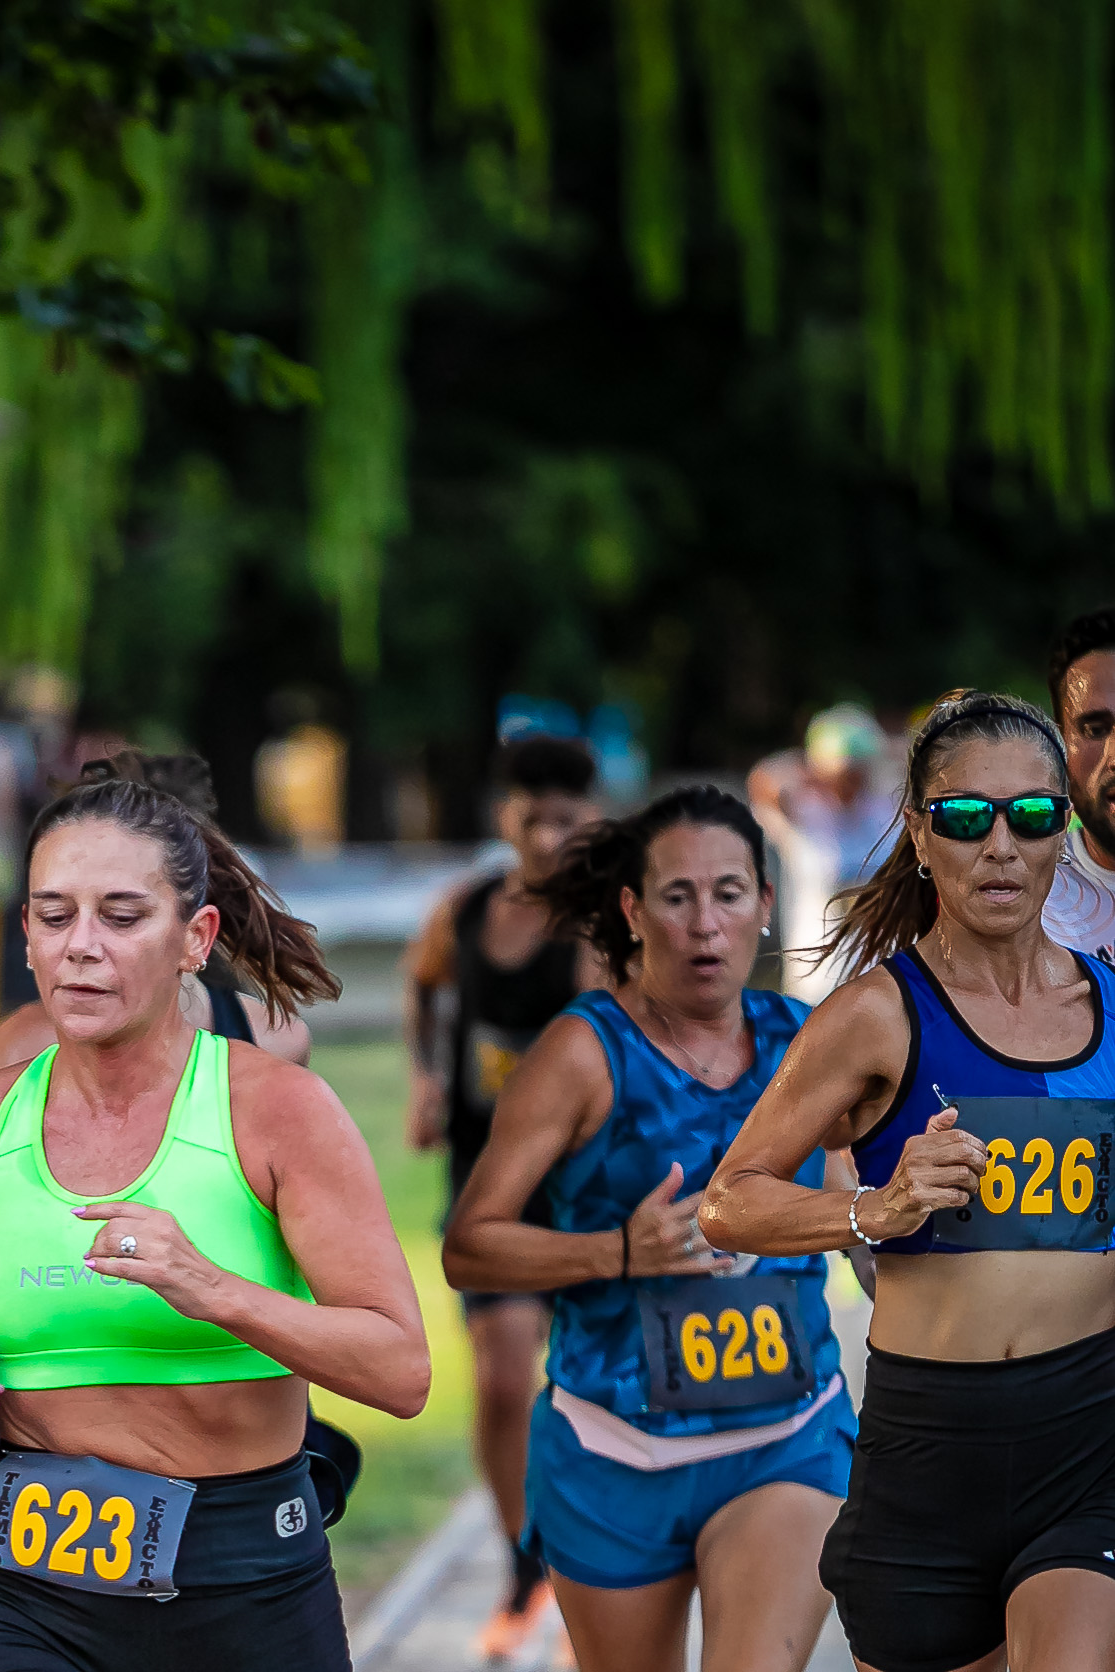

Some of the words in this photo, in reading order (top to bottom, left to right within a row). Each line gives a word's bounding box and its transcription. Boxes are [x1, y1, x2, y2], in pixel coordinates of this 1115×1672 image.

[980, 1137, 1096, 1214] 626
[1095, 1133, 1113, 1223] EXACTO
[680, 1303, 789, 1383] 628
[10, 1482, 136, 1581] 623
[138, 1496, 167, 1589] EXACTO
